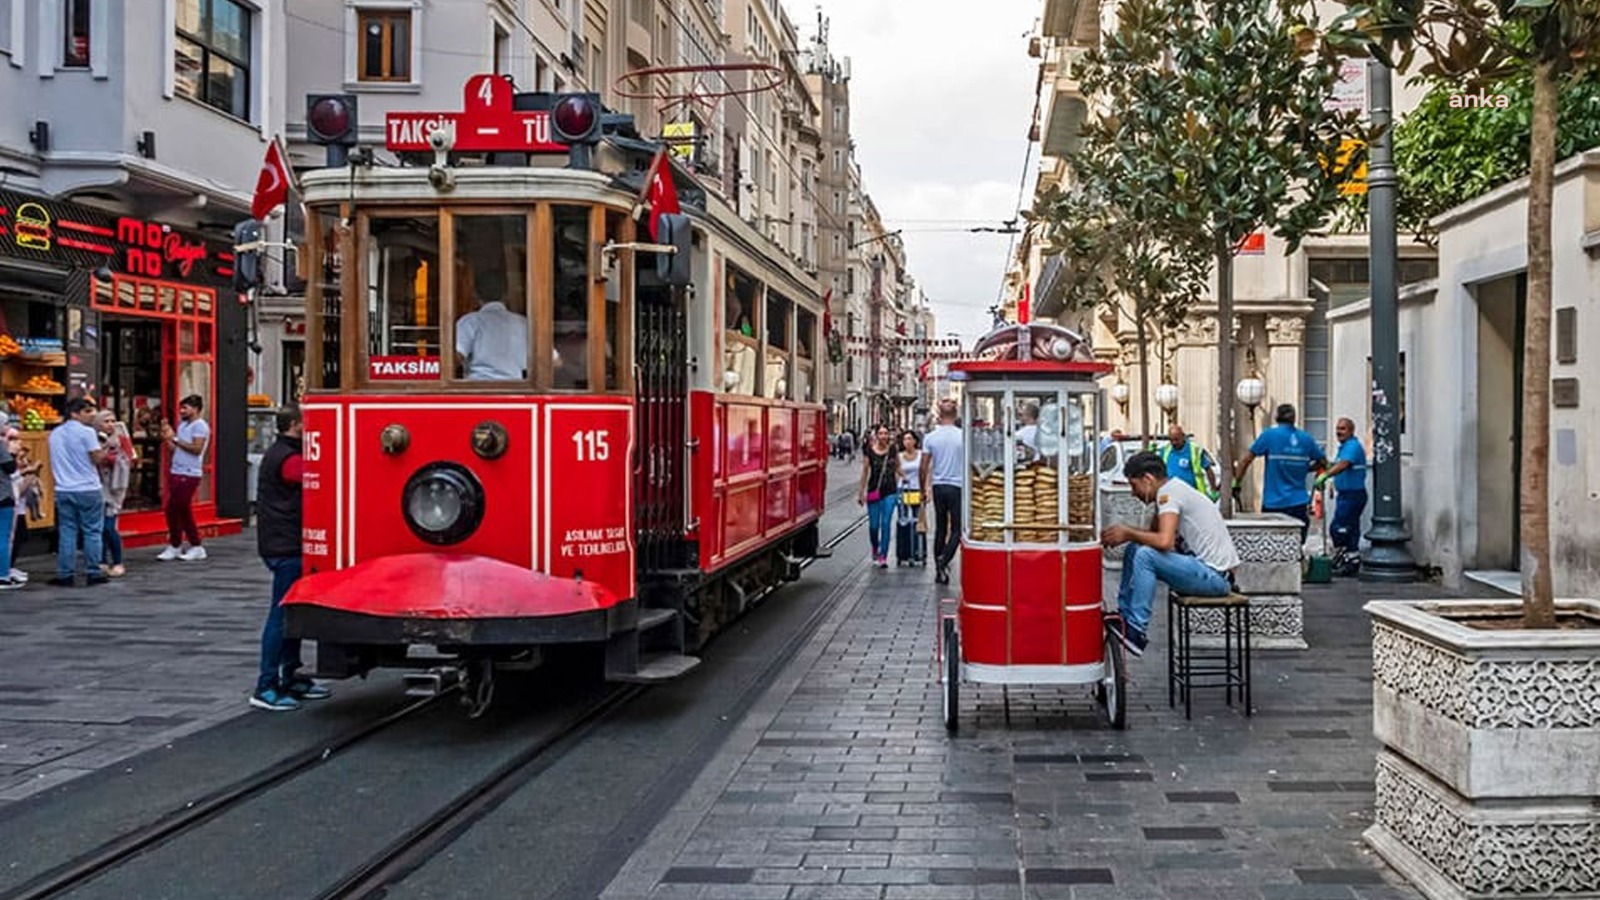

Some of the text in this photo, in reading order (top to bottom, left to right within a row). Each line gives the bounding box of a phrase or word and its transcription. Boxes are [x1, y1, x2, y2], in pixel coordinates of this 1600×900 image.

[478, 77, 494, 106] 4
[522, 114, 552, 144] TÜ
[371, 359, 440, 375] TAKSİM
[572, 430, 609, 461] 115
